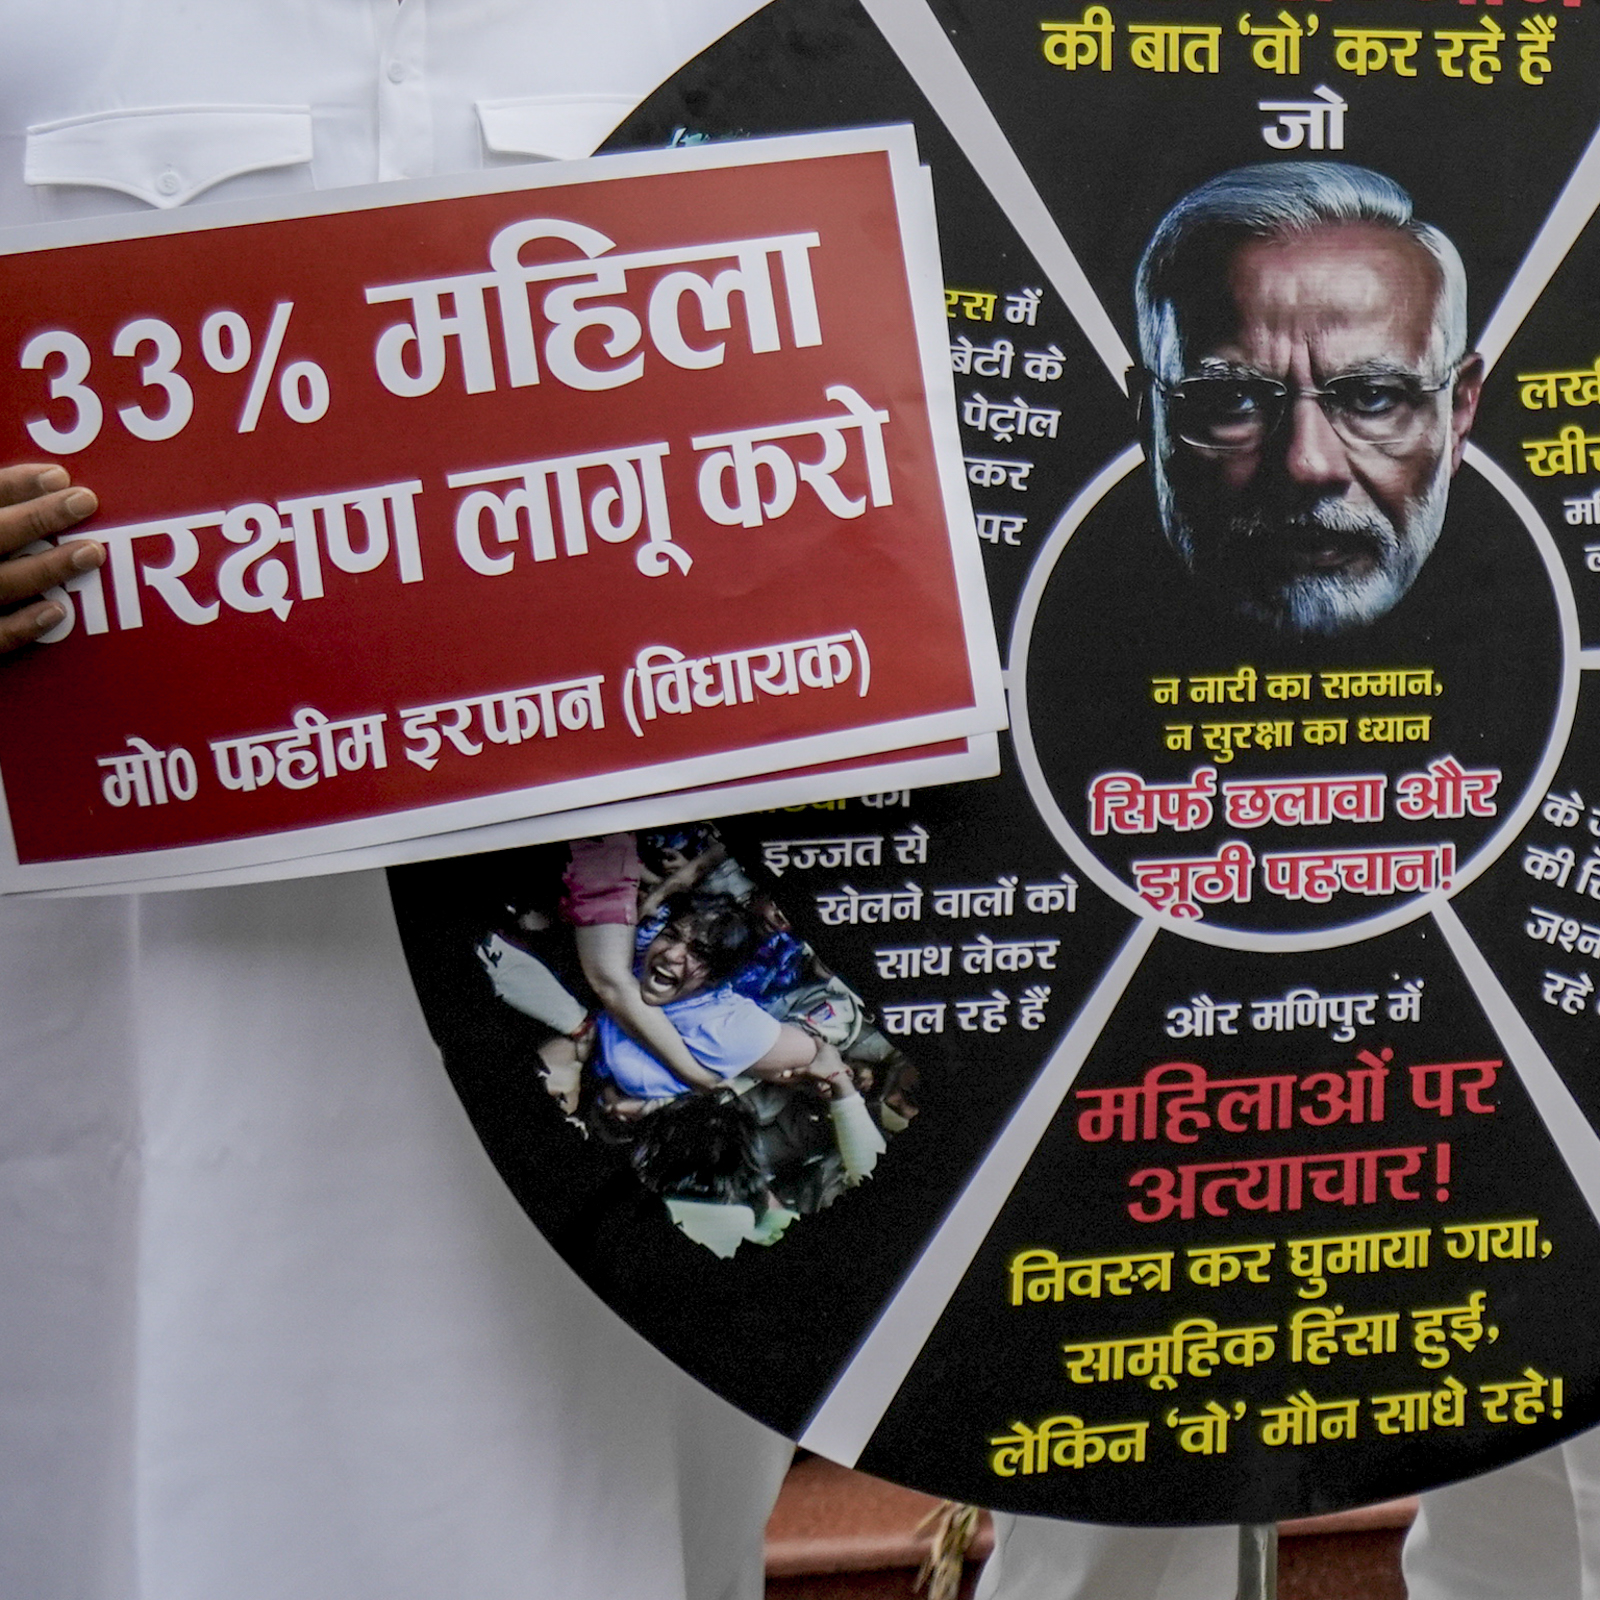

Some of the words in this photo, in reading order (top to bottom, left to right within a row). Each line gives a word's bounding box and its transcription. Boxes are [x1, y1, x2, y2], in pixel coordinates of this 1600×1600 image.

[1041, 6, 1115, 71] की
[1128, 25, 1222, 73] बात
[1333, 29, 1422, 76] कर
[1434, 15, 1505, 84] रहे
[1517, 14, 1557, 85] हैं
[1258, 84, 1348, 149] जो
[21, 302, 329, 454] 33%
[365, 218, 822, 397] महिला
[1024, 345, 1067, 382] के
[963, 392, 1061, 442] पेट्रोल
[447, 442, 693, 576] लागू
[691, 384, 893, 528] करो
[210, 708, 387, 791] फहीम
[400, 675, 604, 770] इरफान
[623, 629, 870, 737] (विधायक)
[1152, 678, 1180, 704] न
[1189, 666, 1257, 703] नारी
[1266, 674, 1312, 700] का
[1320, 669, 1443, 698] सम्मान,
[1088, 765, 1217, 835] सिर्फ
[1221, 773, 1387, 828] छलावा
[1395, 754, 1502, 820] और
[1542, 790, 1585, 827] के
[762, 836, 884, 877] इज्जत
[894, 824, 929, 864] से
[1133, 841, 1255, 920] झूठी
[1264, 843, 1456, 902] पहचान!
[1523, 845, 1575, 887] की
[817, 881, 923, 925] खेलने
[933, 875, 1018, 918] वालों
[1025, 873, 1078, 913] को
[875, 944, 952, 979] साथ
[961, 934, 1060, 973] लेकर
[882, 1002, 946, 1035] चल
[955, 989, 1010, 1032] रहे
[1019, 985, 1051, 1030] हैं
[1166, 993, 1242, 1037] और
[1251, 987, 1379, 1042] मणिपुर
[1387, 983, 1423, 1021] में
[1542, 970, 1594, 1014] रहे
[1075, 1048, 1393, 1143] महिलाओं
[1409, 1060, 1503, 1116] पर
[1128, 1142, 1450, 1222] अत्याचार!
[1187, 1243, 1275, 1287] कर
[1287, 1228, 1431, 1299] घुमाया
[1444, 1219, 1552, 1262] गया,
[1064, 1318, 1278, 1390] सामूहिक
[1289, 1305, 1400, 1365] हिंसा
[1411, 1290, 1499, 1369] हुई,
[991, 1415, 1149, 1476] लेकिन
[1260, 1390, 1360, 1445] मौन
[1371, 1375, 1467, 1434] साधे
[1480, 1367, 1563, 1424] रहे!
